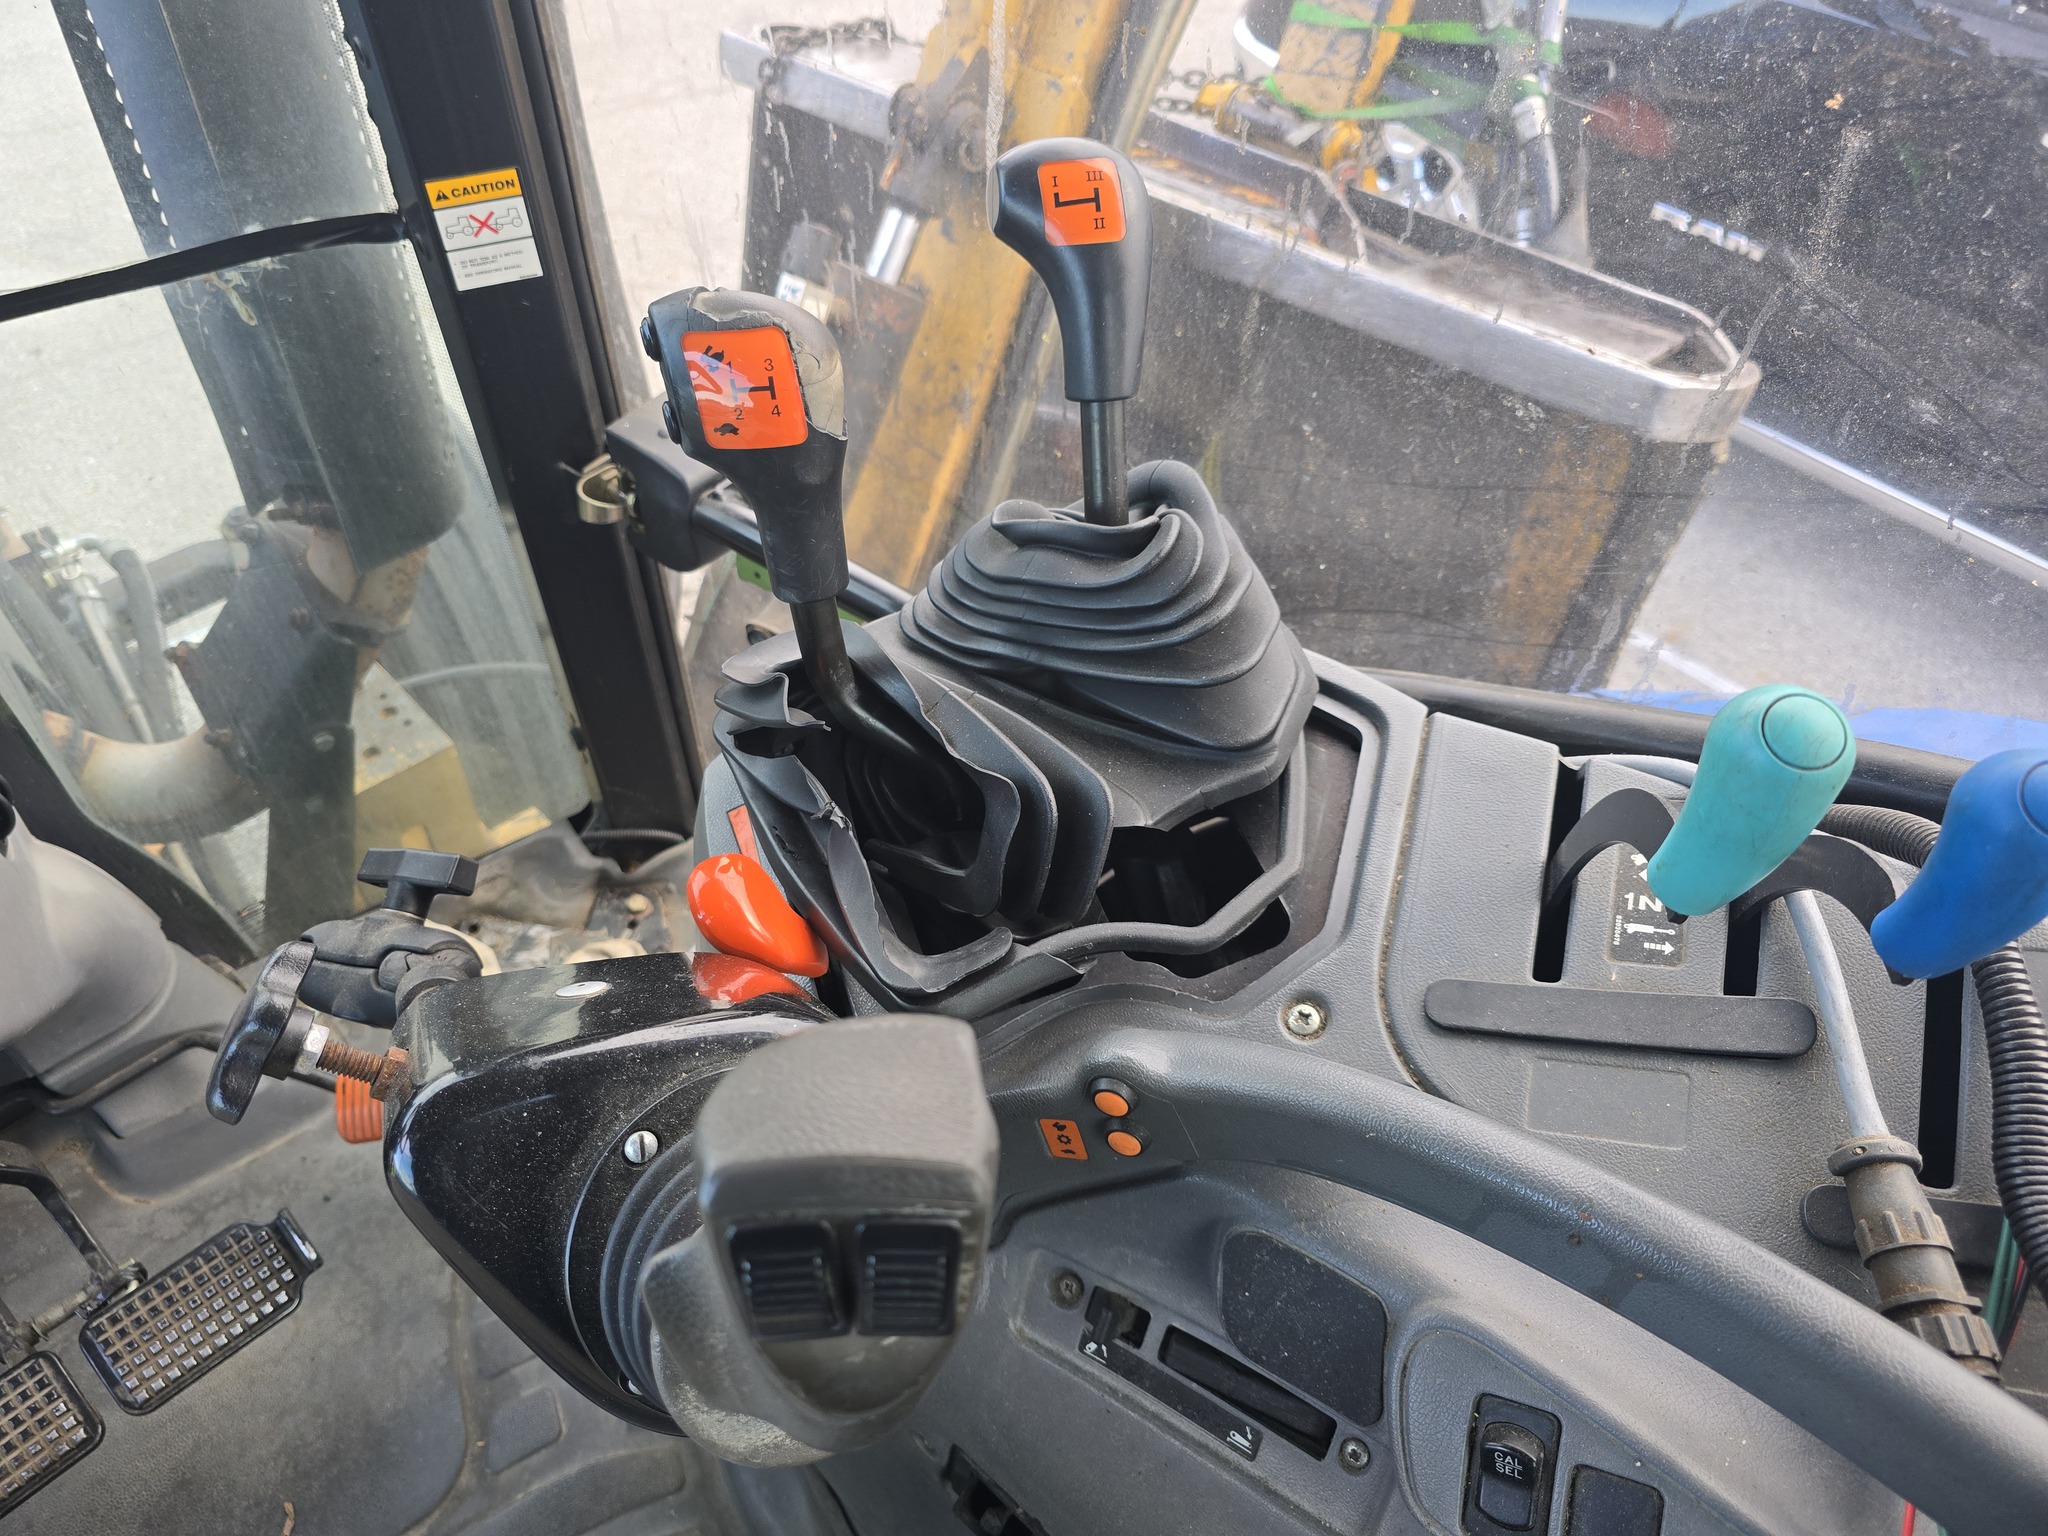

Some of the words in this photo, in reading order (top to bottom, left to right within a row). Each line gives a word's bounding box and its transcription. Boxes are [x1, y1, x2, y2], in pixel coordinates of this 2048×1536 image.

[451, 179, 515, 198] CAUTION
[763, 358, 775, 372] 3
[733, 407, 745, 421] 2
[771, 405, 782, 417] 4
[1494, 1451, 1523, 1469] CAL
[1495, 1463, 1523, 1480] SEL
